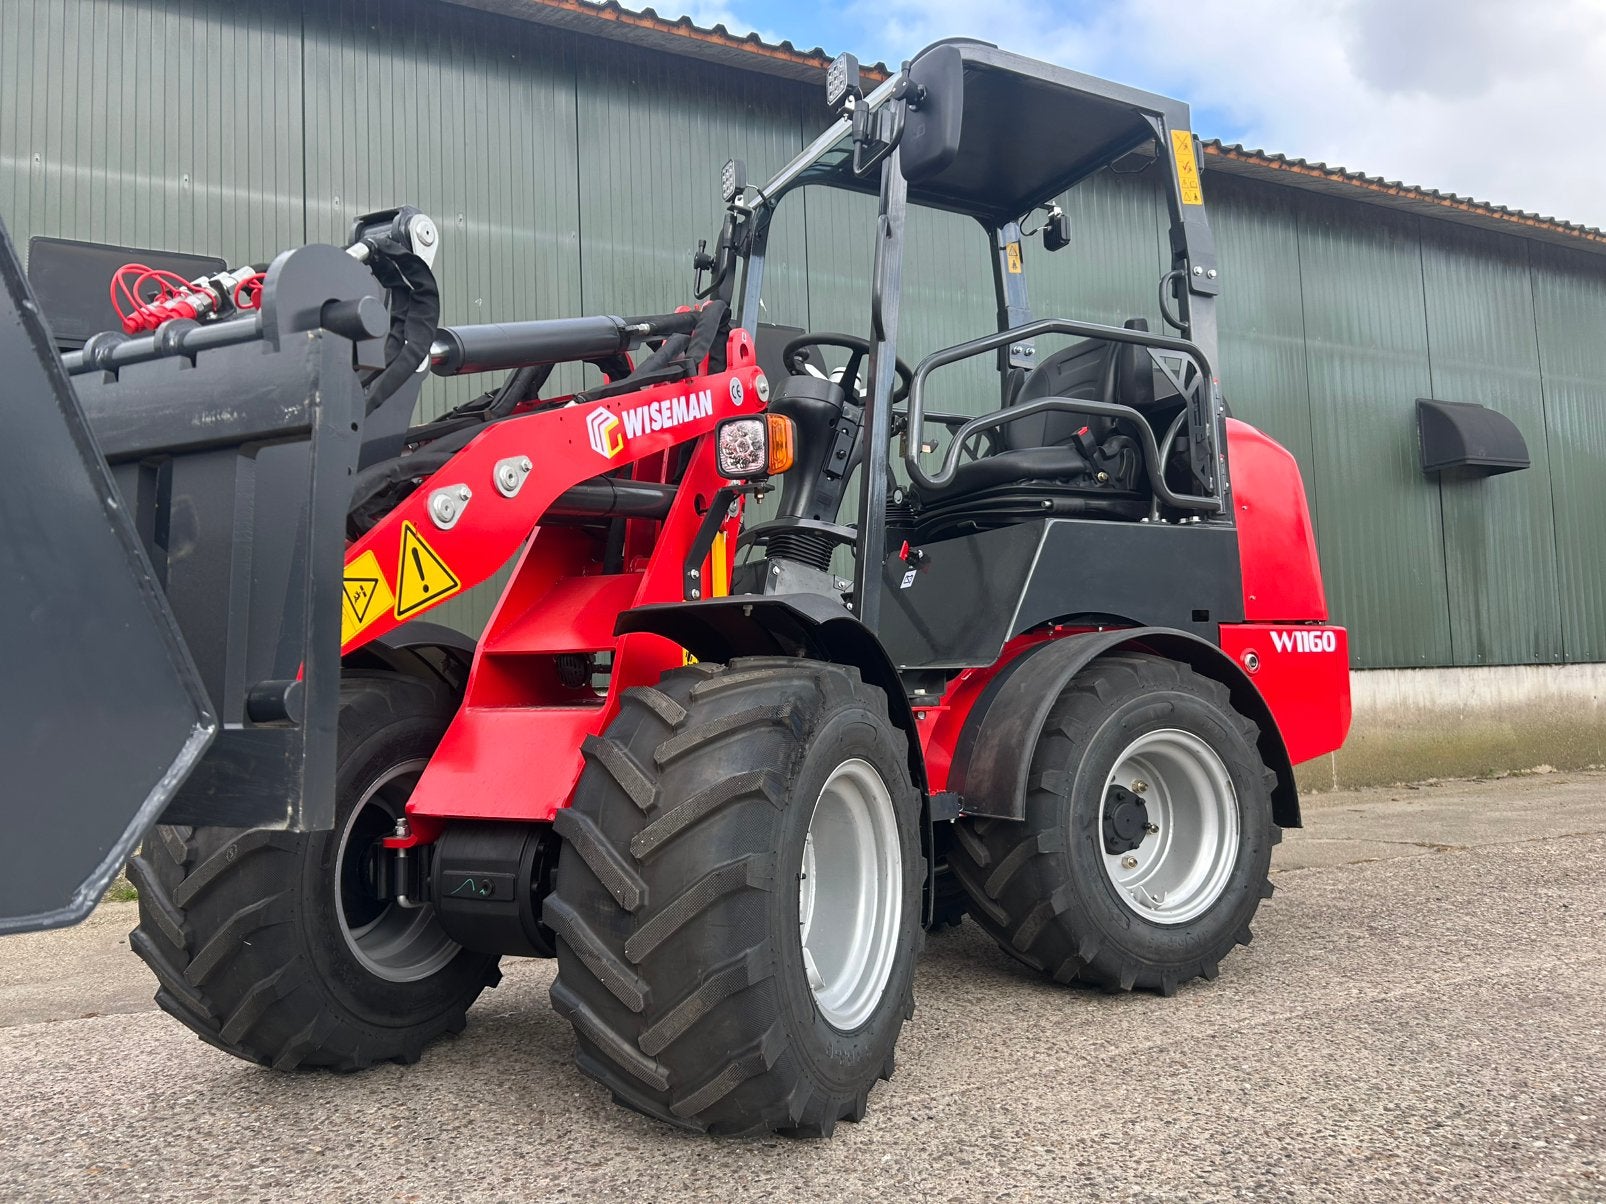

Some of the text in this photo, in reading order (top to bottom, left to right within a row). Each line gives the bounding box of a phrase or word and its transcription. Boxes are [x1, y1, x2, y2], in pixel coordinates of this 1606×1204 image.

[731, 384, 742, 400] CE
[621, 389, 714, 440] WISEMAN
[1269, 630, 1336, 653] W1160
